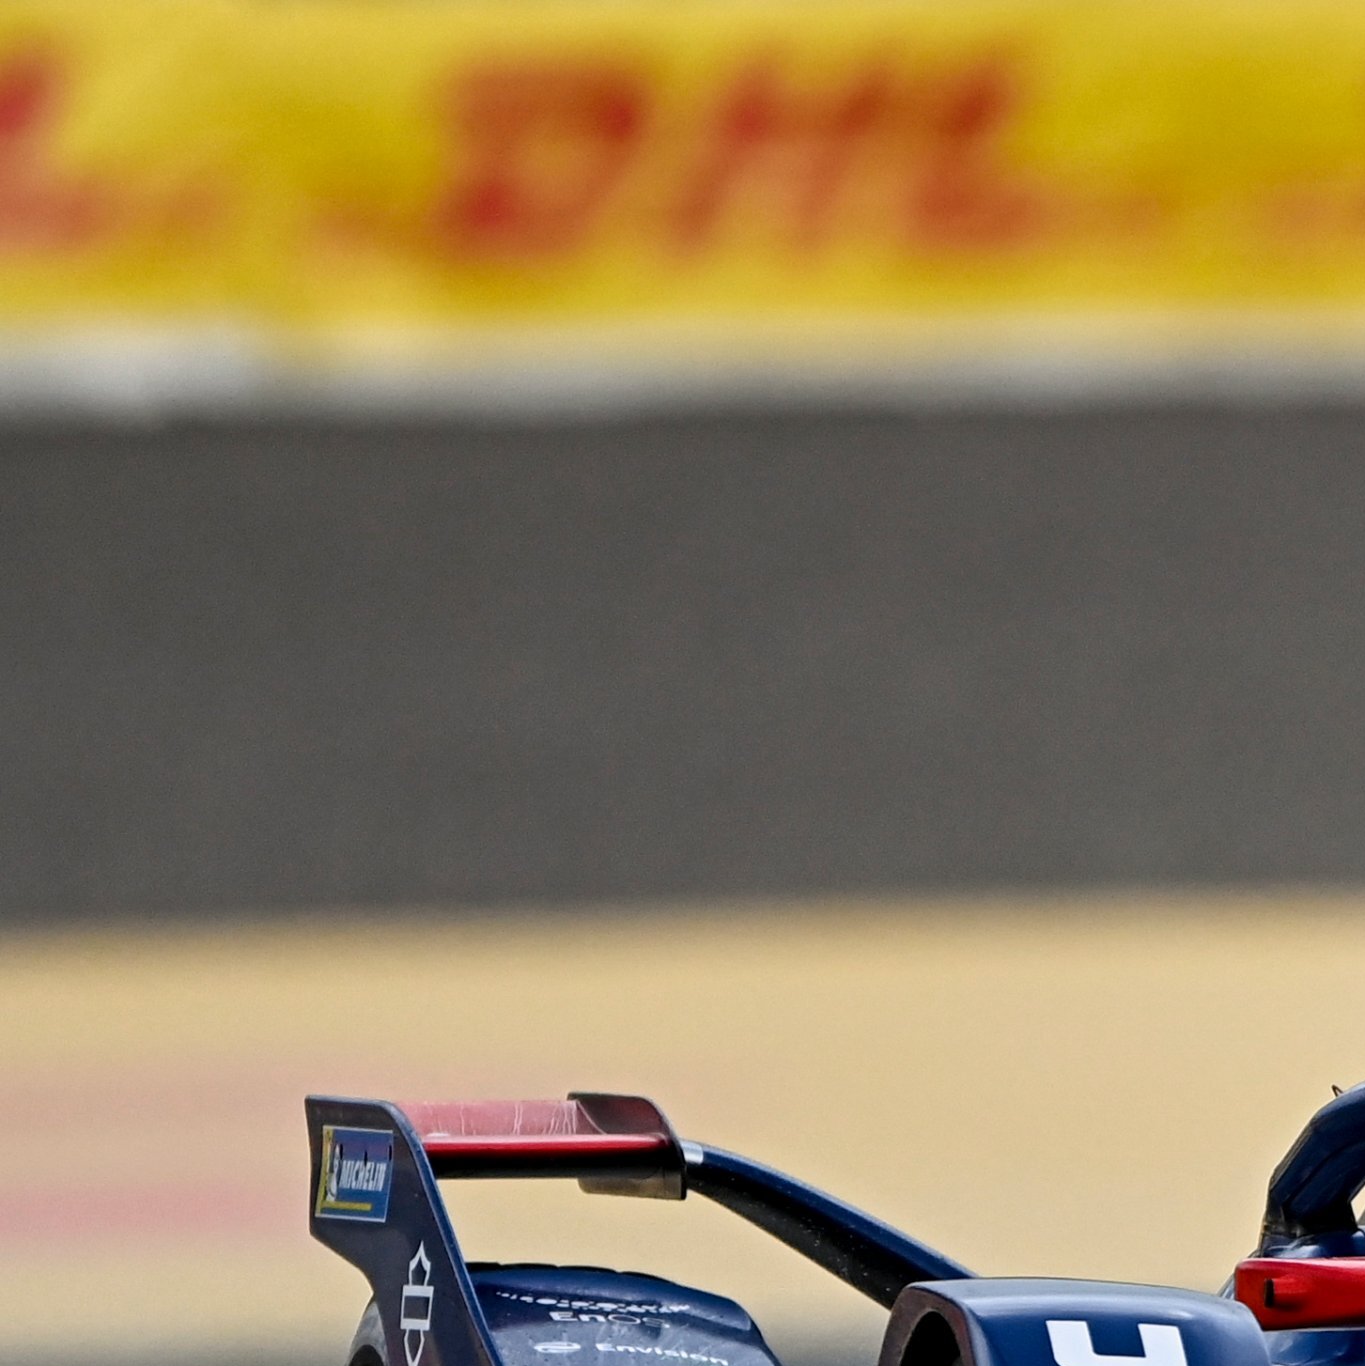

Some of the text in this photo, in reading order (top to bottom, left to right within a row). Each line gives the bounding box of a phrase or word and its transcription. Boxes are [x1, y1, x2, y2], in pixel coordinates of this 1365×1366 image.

[432, 55, 1040, 265] DHL
[338, 1159, 388, 1192] MICHELIN
[595, 1342, 729, 1366] Envision
